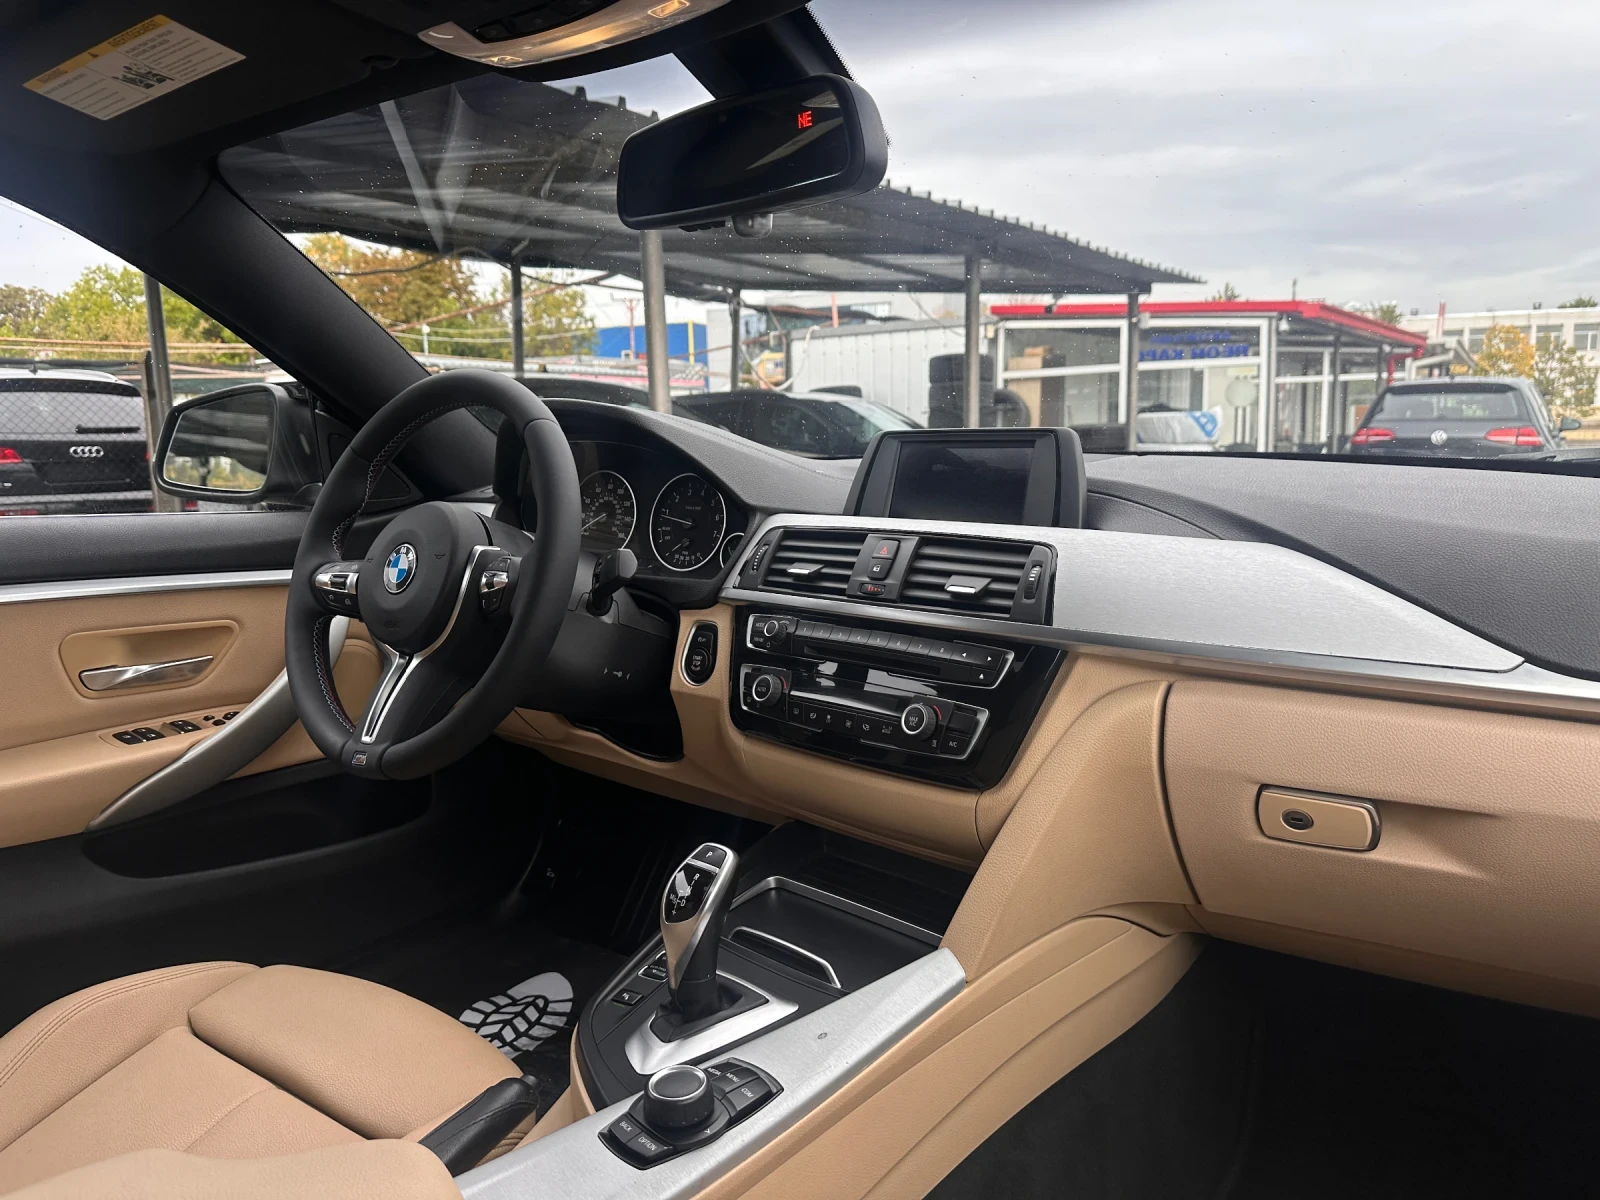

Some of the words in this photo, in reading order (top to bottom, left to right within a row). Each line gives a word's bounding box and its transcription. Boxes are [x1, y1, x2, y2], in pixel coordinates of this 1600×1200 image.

[798, 110, 813, 129] NE
[726, 1072, 740, 1083] MENU
[741, 1087, 754, 1098] COM
[619, 1120, 633, 1132] BACK
[638, 1136, 658, 1151] OPTION
